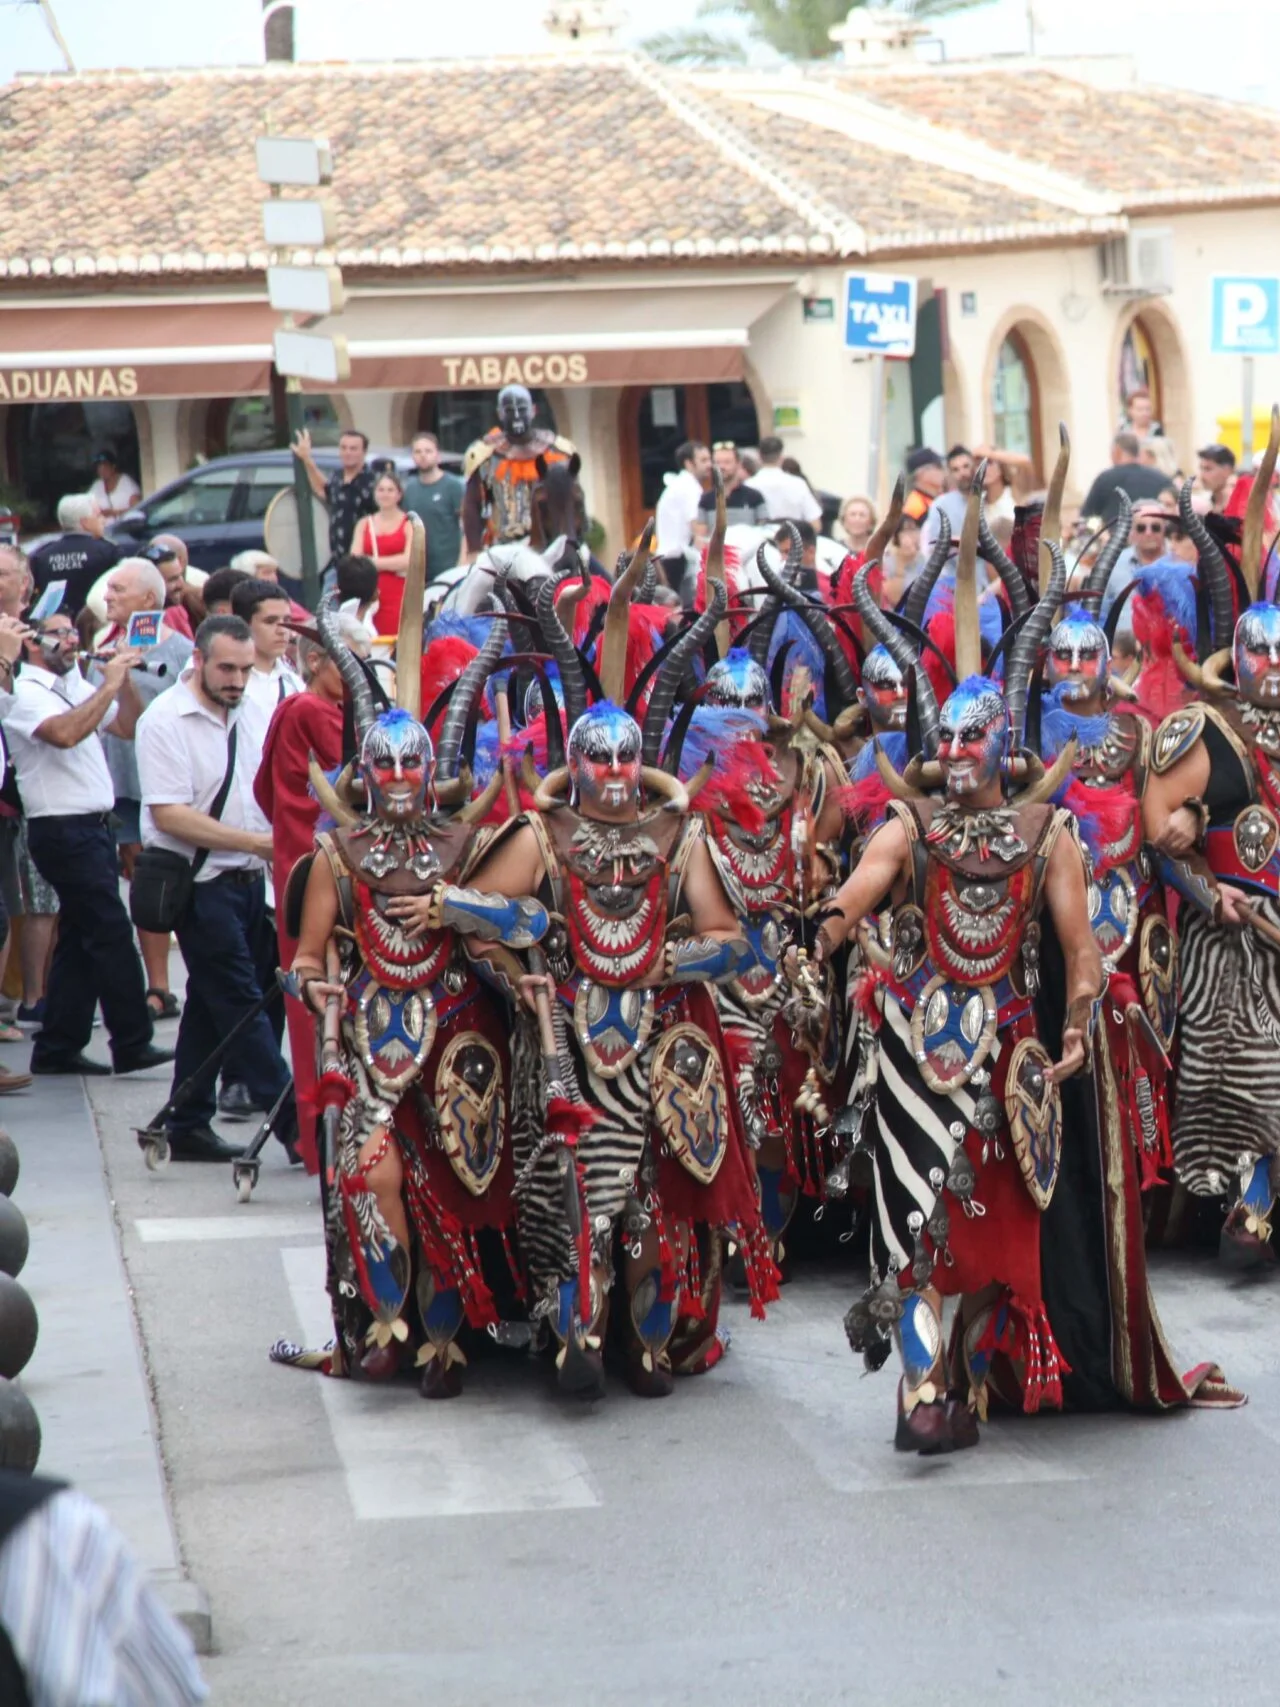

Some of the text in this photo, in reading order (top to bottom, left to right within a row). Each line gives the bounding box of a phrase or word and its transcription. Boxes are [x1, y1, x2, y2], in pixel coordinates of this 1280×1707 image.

[849, 301, 907, 325] TAXI
[1223, 282, 1269, 347] P
[442, 353, 589, 386] TABACOS
[49, 552, 88, 565] POLICIA
[52, 560, 84, 572] LOCAL
